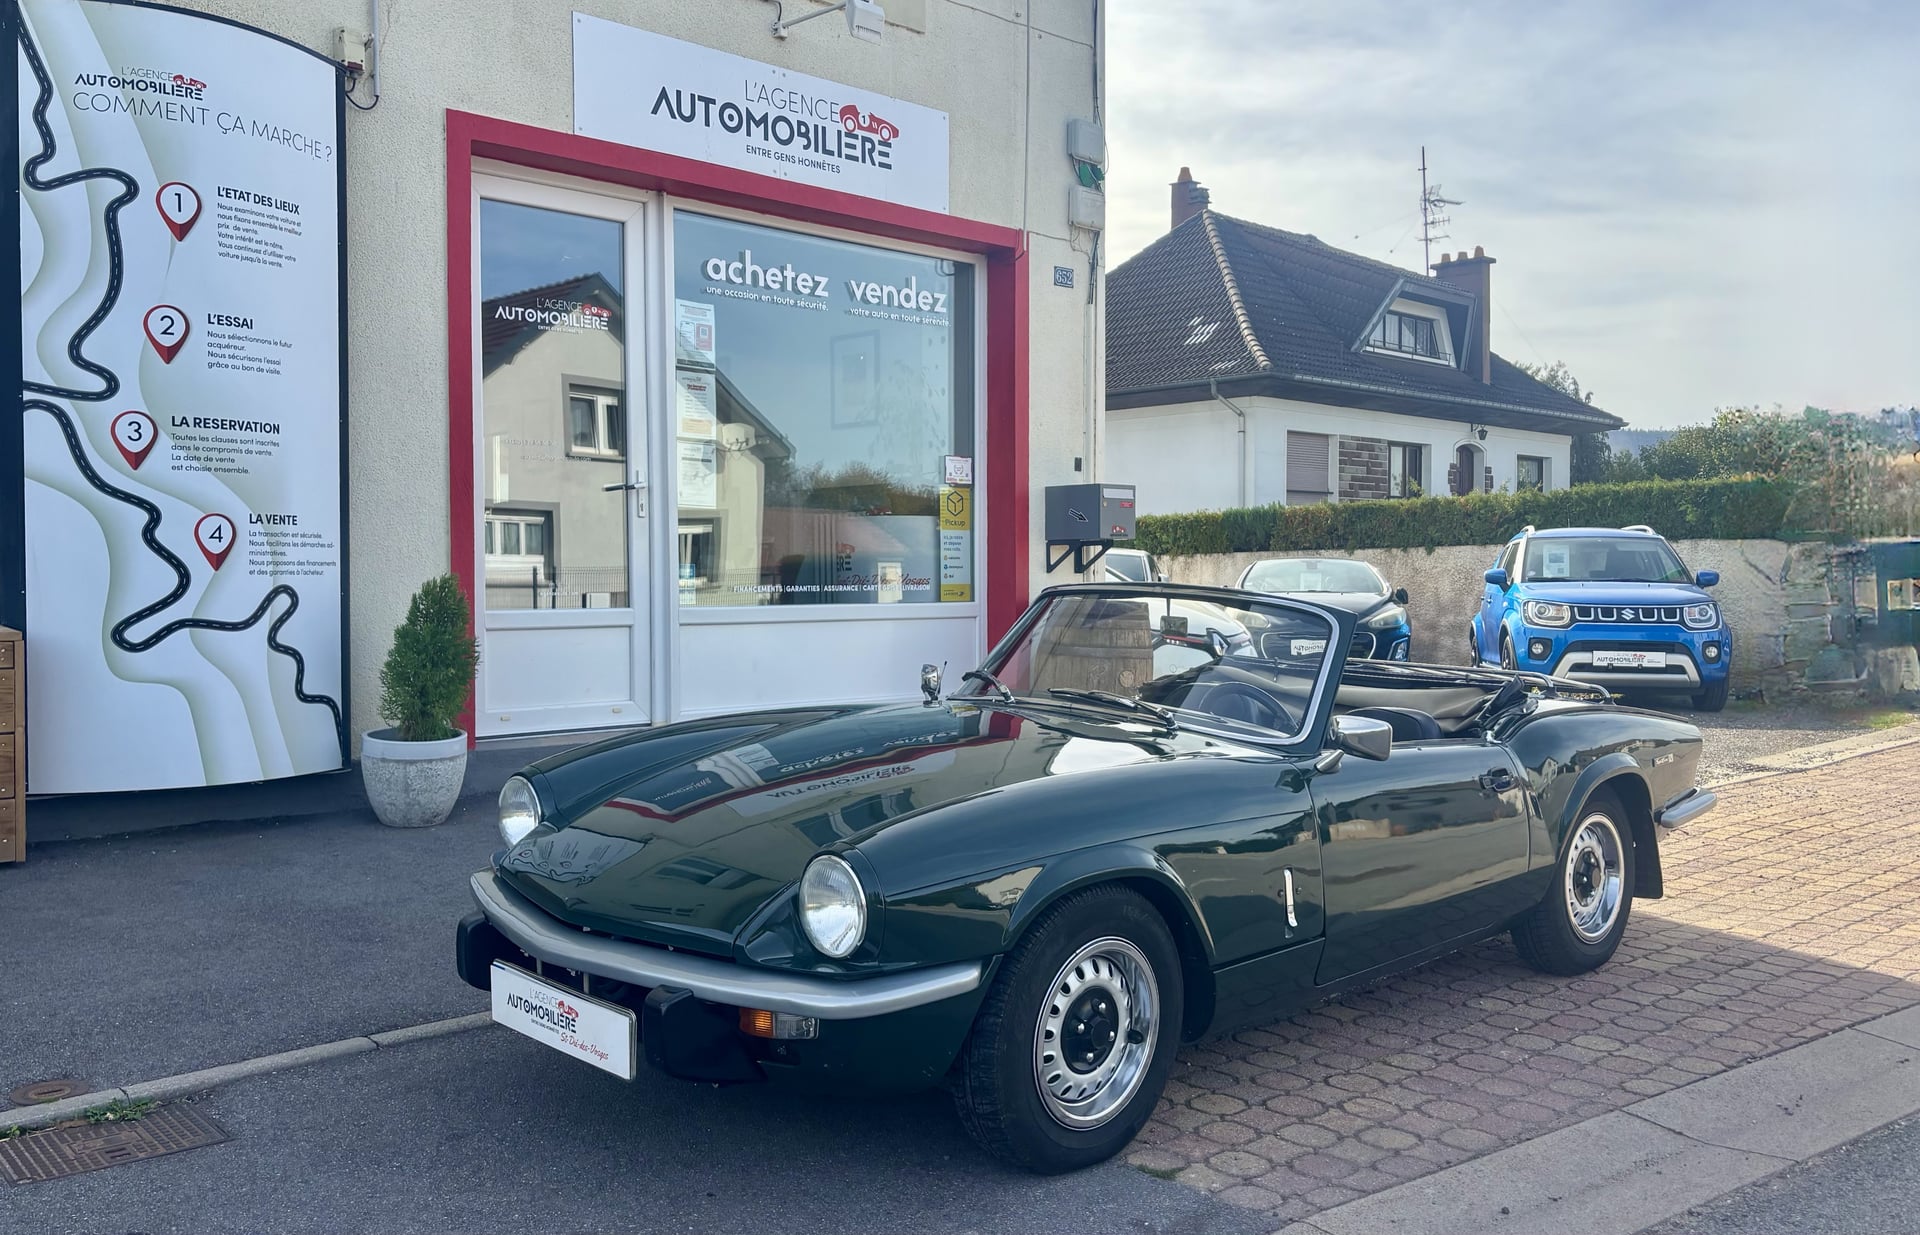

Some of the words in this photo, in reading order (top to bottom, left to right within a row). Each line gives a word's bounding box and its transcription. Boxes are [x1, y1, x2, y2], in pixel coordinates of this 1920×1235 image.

[121, 66, 174, 81] L'AGENCE
[744, 80, 840, 124] L'AGENCE
[73, 92, 210, 126] COMMENT
[216, 112, 245, 134] ÇA
[252, 120, 322, 159] MARCHE
[746, 145, 772, 159] ENTRE
[773, 151, 796, 164] GENS
[798, 156, 841, 174] HONNÊTES
[174, 193, 182, 213] 1
[217, 186, 251, 202] L'ETAT
[253, 193, 273, 208] DES
[275, 199, 300, 215] LIEUX
[217, 202, 233, 212] Nous
[234, 207, 265, 218] examinons
[217, 213, 233, 221] nous
[233, 215, 251, 224] fixons
[252, 219, 278, 230] ensemble
[217, 222, 230, 230] prix
[217, 231, 234, 240] Votre
[217, 240, 233, 249] Vous
[217, 251, 240, 259] voiture
[706, 249, 830, 298] achetez
[706, 287, 722, 295] une
[724, 289, 759, 300] occasion
[773, 295, 795, 306] toute
[850, 276, 947, 313] vendez
[536, 297, 583, 312] L'AGENCE
[207, 313, 253, 330] L'ESSAI
[850, 308, 869, 316] votre
[871, 311, 888, 319] auto
[901, 314, 921, 323] toute
[160, 315, 175, 336] 2
[207, 330, 226, 340] Nous
[227, 333, 272, 346] sélectionnons
[207, 351, 226, 359] Nous
[227, 352, 263, 364] sécurisons
[207, 361, 230, 369] grâce
[241, 364, 255, 372] bon
[127, 421, 142, 442] 3
[171, 415, 190, 428] LA
[193, 417, 280, 435] RESERVATION
[171, 433, 197, 441] Toutes
[198, 434, 209, 442] les
[211, 436, 238, 444] clauses
[255, 438, 280, 448] inscrites
[171, 443, 191, 451] dans
[193, 444, 200, 452] le
[201, 446, 243, 455] compromis
[183, 454, 202, 462] date
[203, 455, 214, 463] de
[171, 464, 183, 472] est
[184, 464, 212, 473] choisie
[249, 513, 264, 525] LA
[266, 514, 298, 526] VENTE
[945, 519, 966, 527] Pickup
[208, 523, 224, 543] 4
[266, 540, 291, 548] facilitons
[266, 560, 295, 568] proposons
[269, 569, 295, 577] garanties
[733, 584, 783, 593] FINANCEMENTS
